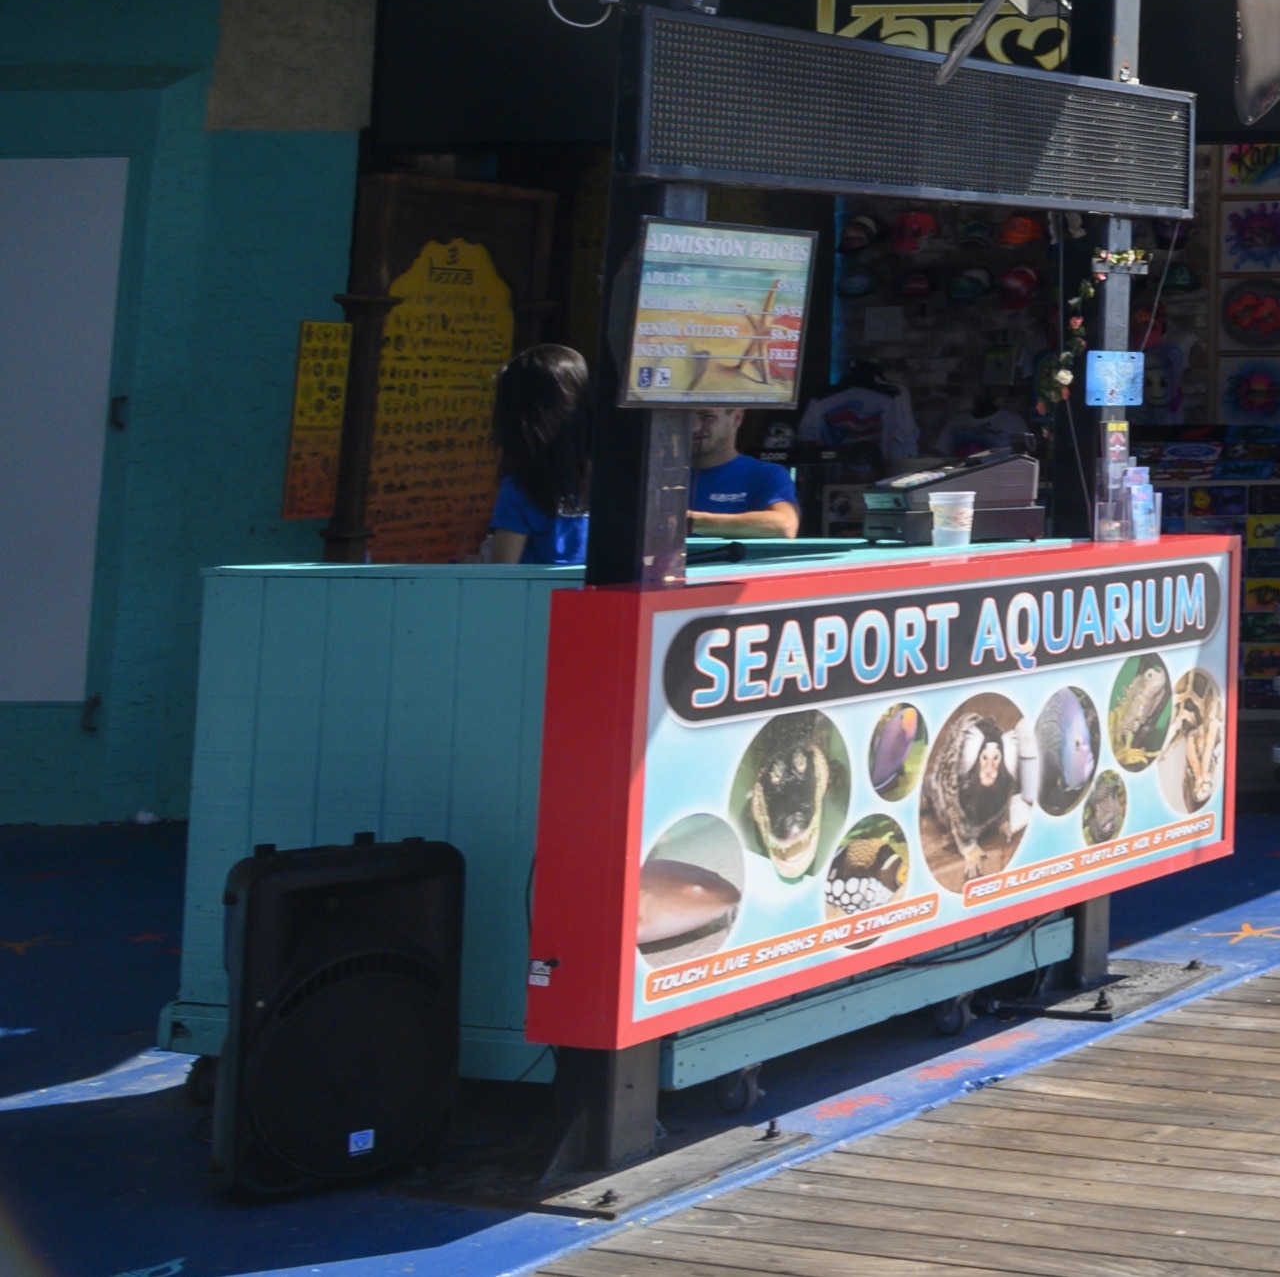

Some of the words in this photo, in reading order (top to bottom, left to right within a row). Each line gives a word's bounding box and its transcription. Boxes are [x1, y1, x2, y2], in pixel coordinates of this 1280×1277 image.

[646, 233, 747, 258] ADMISSION
[749, 241, 809, 263] PRICES
[642, 271, 691, 286] ADULTS
[637, 322, 681, 337] SENIOR
[683, 323, 740, 338] CITIZENS
[633, 343, 688, 357] INFANTS
[769, 348, 798, 360] FREE
[691, 601, 959, 711] SEAPORT
[969, 572, 1207, 671] AQUARIUM
[967, 878, 1002, 900] FEED
[1152, 832, 1163, 846] &
[651, 964, 708, 994] TOUCH
[712, 952, 752, 976] LIVE
[753, 934, 818, 965] SHARKS
[820, 923, 853, 945] AND
[853, 899, 936, 935] STINGRAYS!
